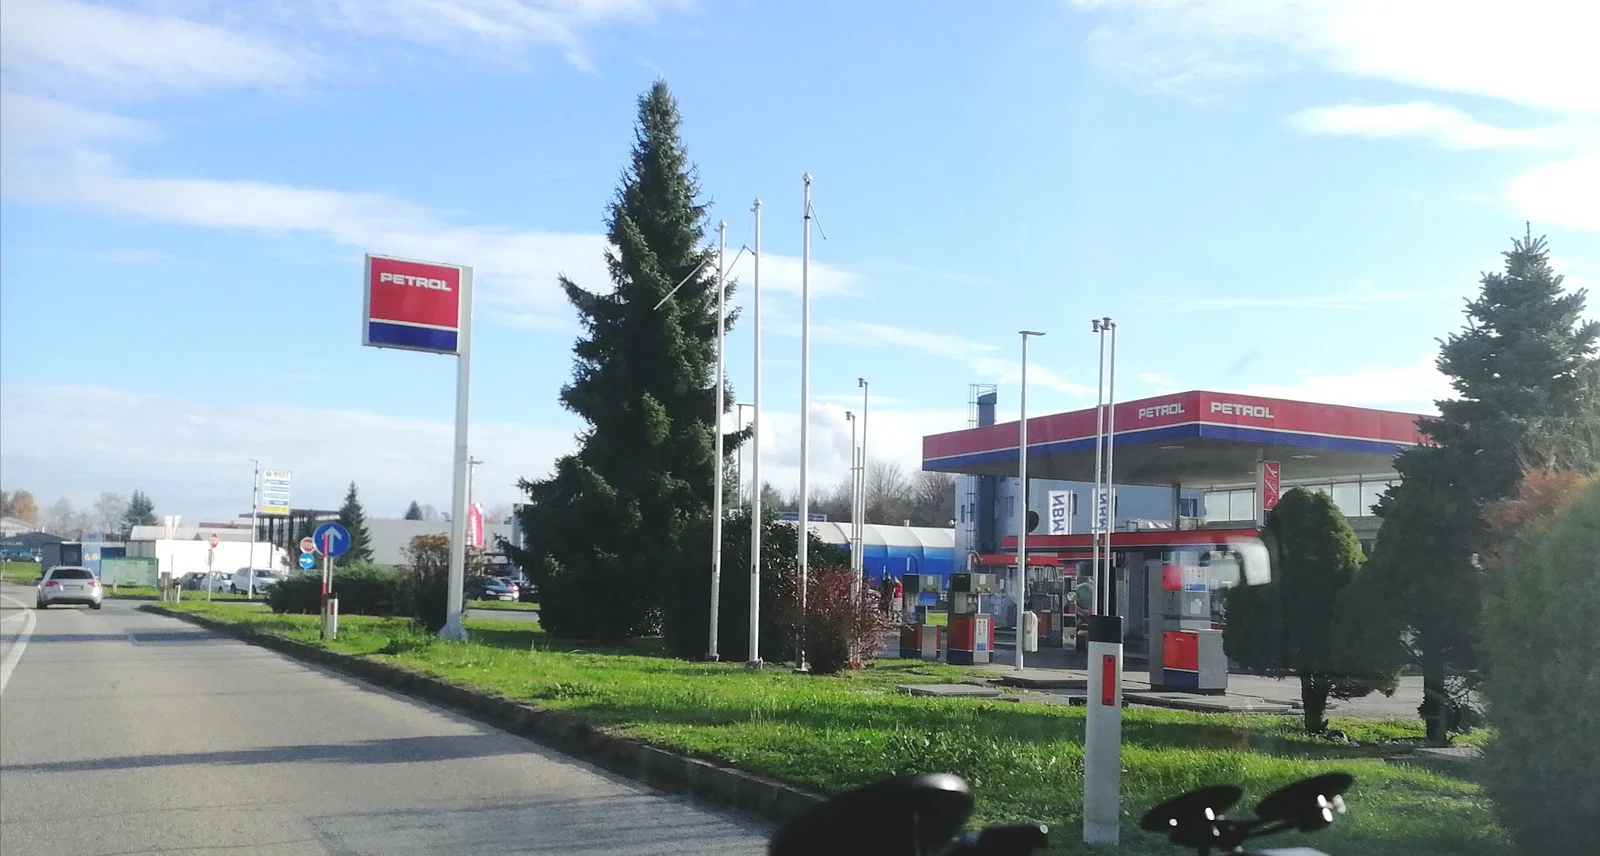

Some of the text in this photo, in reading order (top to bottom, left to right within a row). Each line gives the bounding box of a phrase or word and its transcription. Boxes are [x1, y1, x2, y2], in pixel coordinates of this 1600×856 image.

[379, 272, 452, 292] PETROL
[1138, 402, 1185, 420] PETROL
[1210, 401, 1275, 419] PETROL
